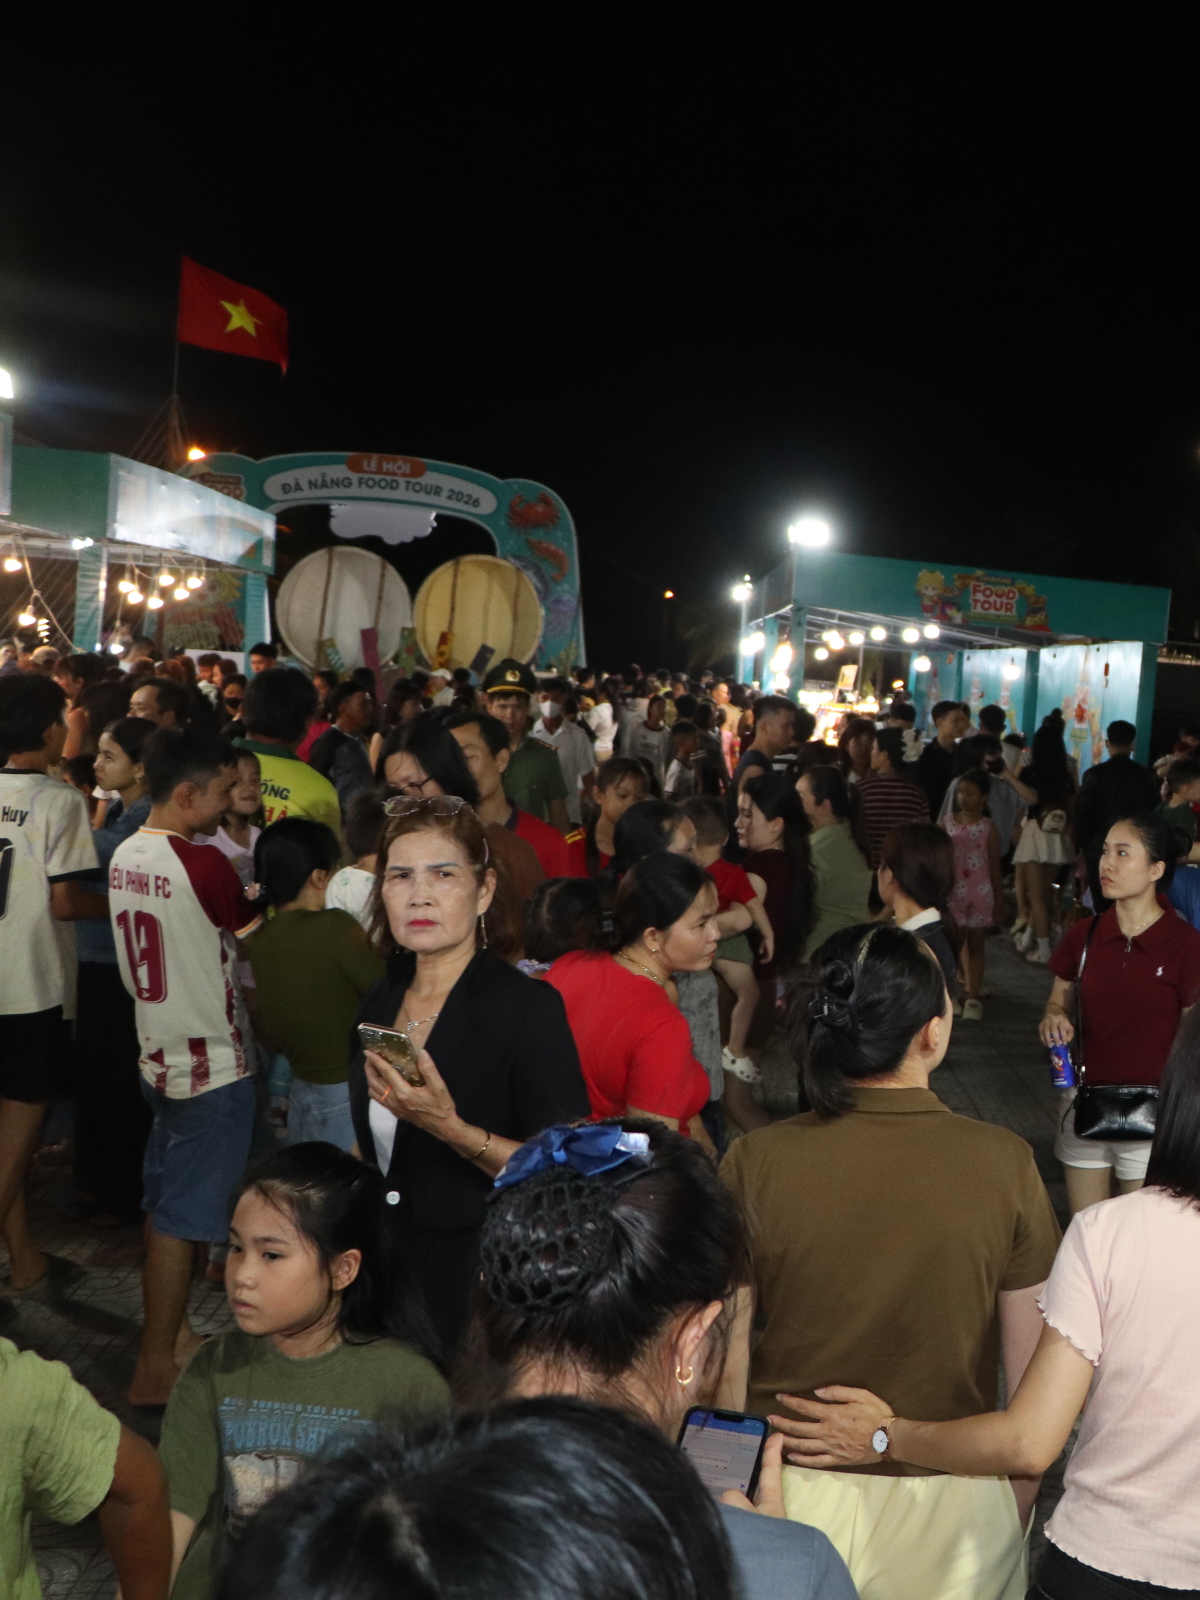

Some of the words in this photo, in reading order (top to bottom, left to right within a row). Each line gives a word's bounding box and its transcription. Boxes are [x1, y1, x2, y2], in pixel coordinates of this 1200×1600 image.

[281, 477, 304, 495] ĐÀ
[357, 477, 400, 491] FOOD
[404, 480, 442, 498] TOUR
[446, 487, 482, 508] 2026
[972, 584, 1016, 600] FOOD
[971, 599, 1014, 614] TOUR
[261, 779, 291, 801] ỐNG
[2, 805, 30, 827] Huy
[155, 875, 171, 899] FC
[116, 909, 168, 1004] 19
[252, 1399, 303, 1412] THROUGH
[306, 1405, 327, 1415] THE
